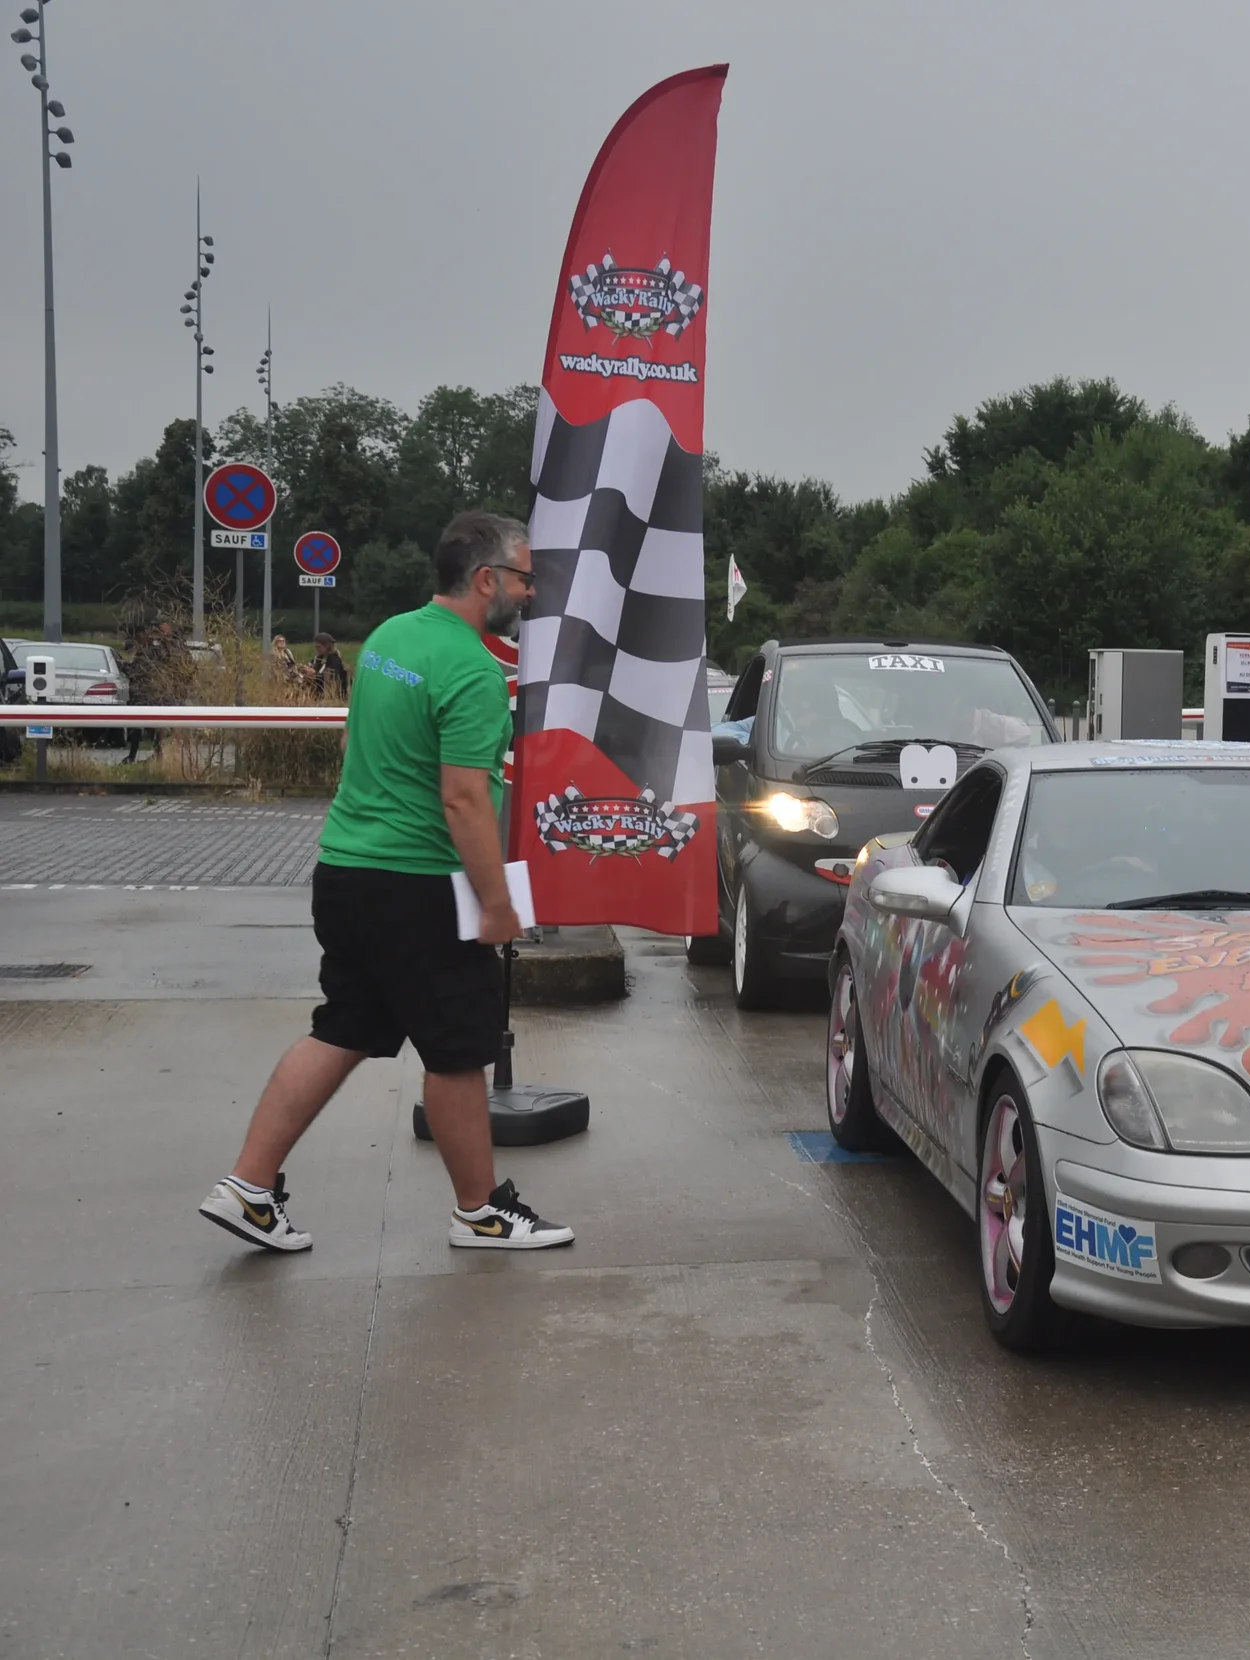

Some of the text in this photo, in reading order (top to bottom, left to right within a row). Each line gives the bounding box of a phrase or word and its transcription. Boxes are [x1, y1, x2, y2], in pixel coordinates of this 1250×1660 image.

[590, 288, 675, 315] Wacky Rally
[560, 354, 698, 382] wackyrally.co.uk
[216, 534, 247, 545] SAUF
[302, 577, 322, 585] SAUF
[382, 658, 424, 687] Crew
[872, 656, 940, 672] TAXI
[554, 816, 666, 840] Wacky Rally
[1068, 1205, 1083, 1215] Holmes
[1084, 1210, 1104, 1223] Memorial
[1104, 1218, 1116, 1227] Fund
[1056, 1206, 1154, 1269] EHMF
[1056, 1246, 1070, 1256] Mental
[1071, 1251, 1085, 1262] Health
[1086, 1257, 1105, 1269] Support
[1116, 1266, 1134, 1276] Young
[1135, 1270, 1156, 1279] People
